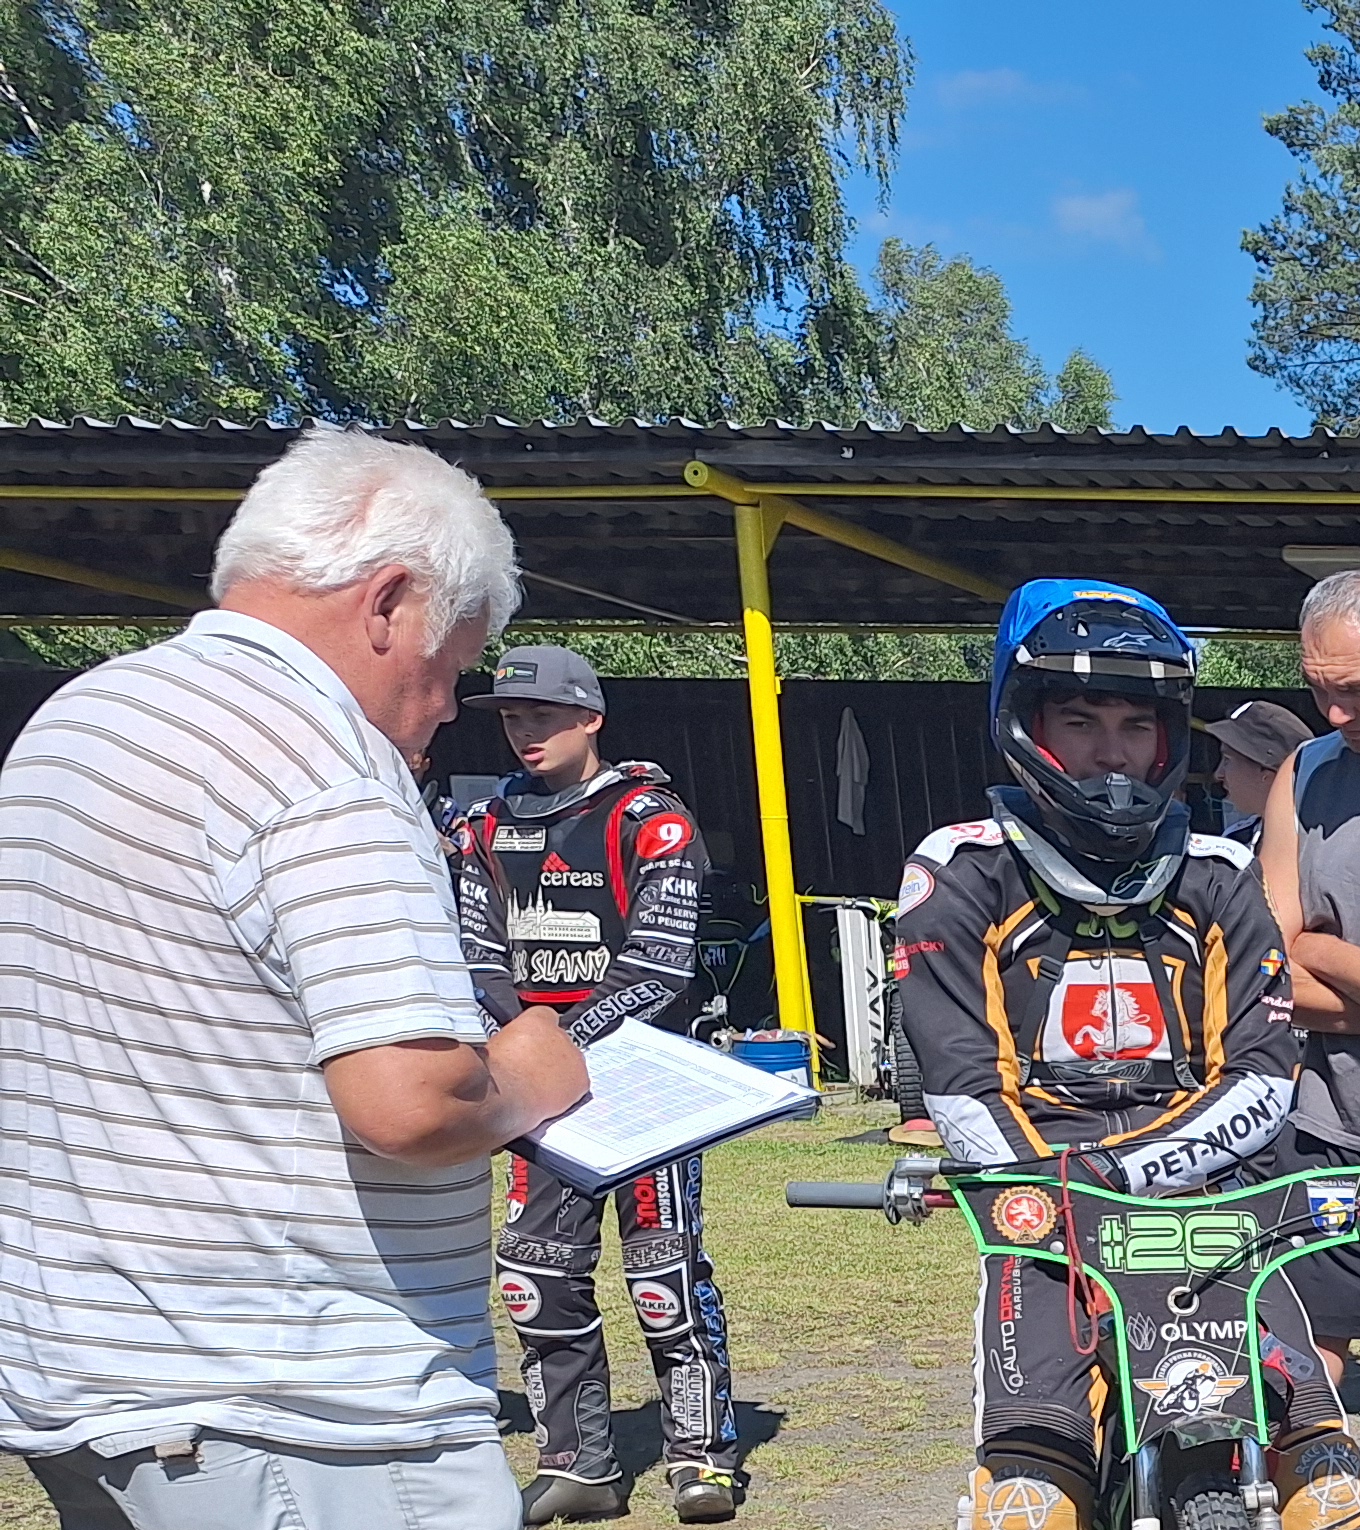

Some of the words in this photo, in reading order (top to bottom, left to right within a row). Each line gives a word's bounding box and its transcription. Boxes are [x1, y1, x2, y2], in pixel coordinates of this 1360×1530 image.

[540, 872, 604, 887] cereas
[661, 876, 698, 899] KHK
[1160, 1321, 1249, 1343] OLYMP
[690, 1363, 705, 1445] ALUMINIU
